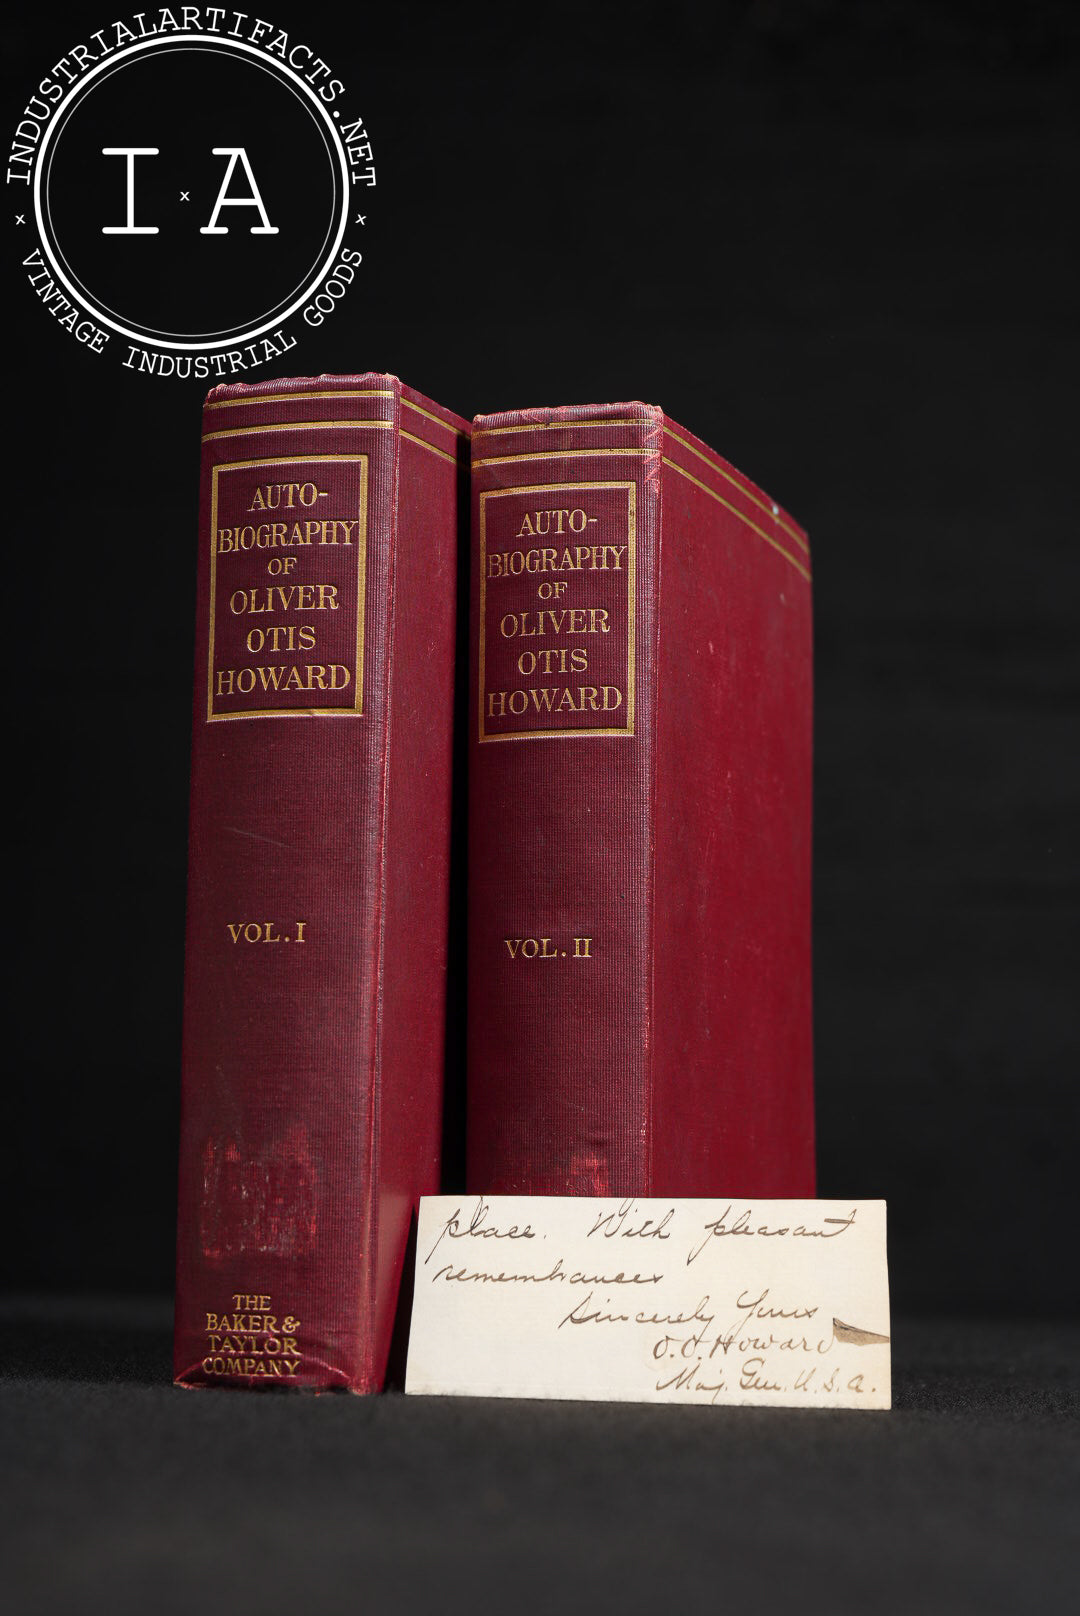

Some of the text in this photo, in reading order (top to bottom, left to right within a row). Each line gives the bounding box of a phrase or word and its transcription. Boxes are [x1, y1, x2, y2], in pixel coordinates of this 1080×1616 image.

[246, 482, 329, 512] AUTO-
[217, 520, 359, 554] BIOGRAPHY
[516, 508, 598, 537] AUTO-
[267, 557, 298, 576] OF
[487, 545, 628, 578] BIOGRAPHY
[229, 584, 340, 615] OLIVER
[537, 582, 568, 600] OF
[500, 609, 611, 638] OLIVER
[246, 626, 317, 653] OTIS
[517, 649, 589, 676] OTIS
[216, 664, 351, 696] HOWARD
[488, 686, 623, 717] HOWARD
[586, 1199, 677, 1239] With
[687, 1205, 857, 1266] pleasant
[232, 1294, 272, 1311] THE
[205, 1312, 280, 1333] BAKER
[558, 1291, 715, 1347] Sincerely
[208, 1335, 302, 1355] TAYLOR
[202, 1357, 300, 1377] COMPANY
[656, 1363, 728, 1404] Maj.
